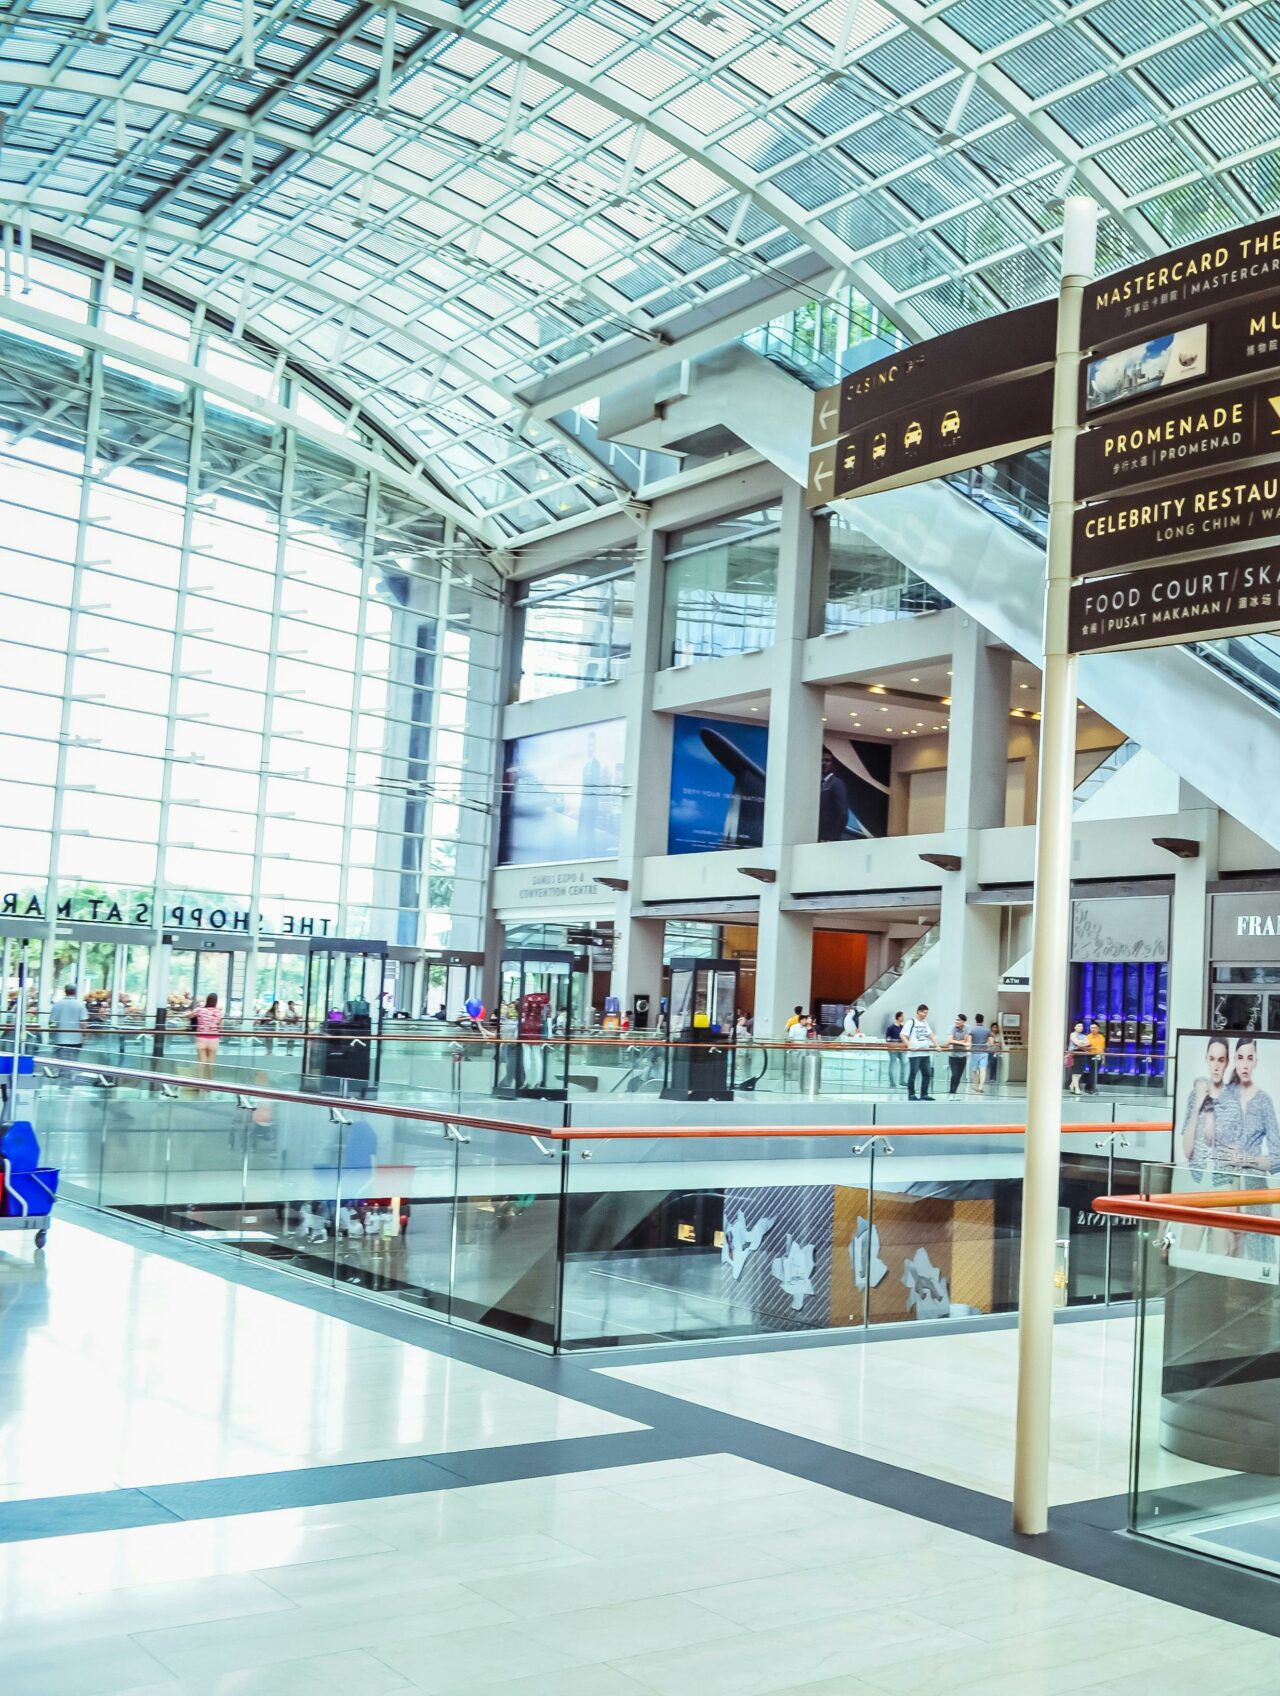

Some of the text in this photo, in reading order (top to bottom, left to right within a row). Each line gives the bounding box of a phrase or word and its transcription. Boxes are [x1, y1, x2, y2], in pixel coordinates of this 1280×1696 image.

[1096, 246, 1231, 311] MASTERCARD
[1103, 402, 1245, 457] PROMENADE
[1160, 432, 1243, 462] PROMENAD
[1085, 496, 1186, 540] CELEBRITY
[1156, 522, 1196, 543] LONG
[1202, 513, 1242, 535] CHIM
[1085, 588, 1142, 616] FOOD
[1108, 611, 1148, 632] PUSAT
[1151, 600, 1222, 625] MAKANAN
[568, 884, 598, 896] CENTRE
